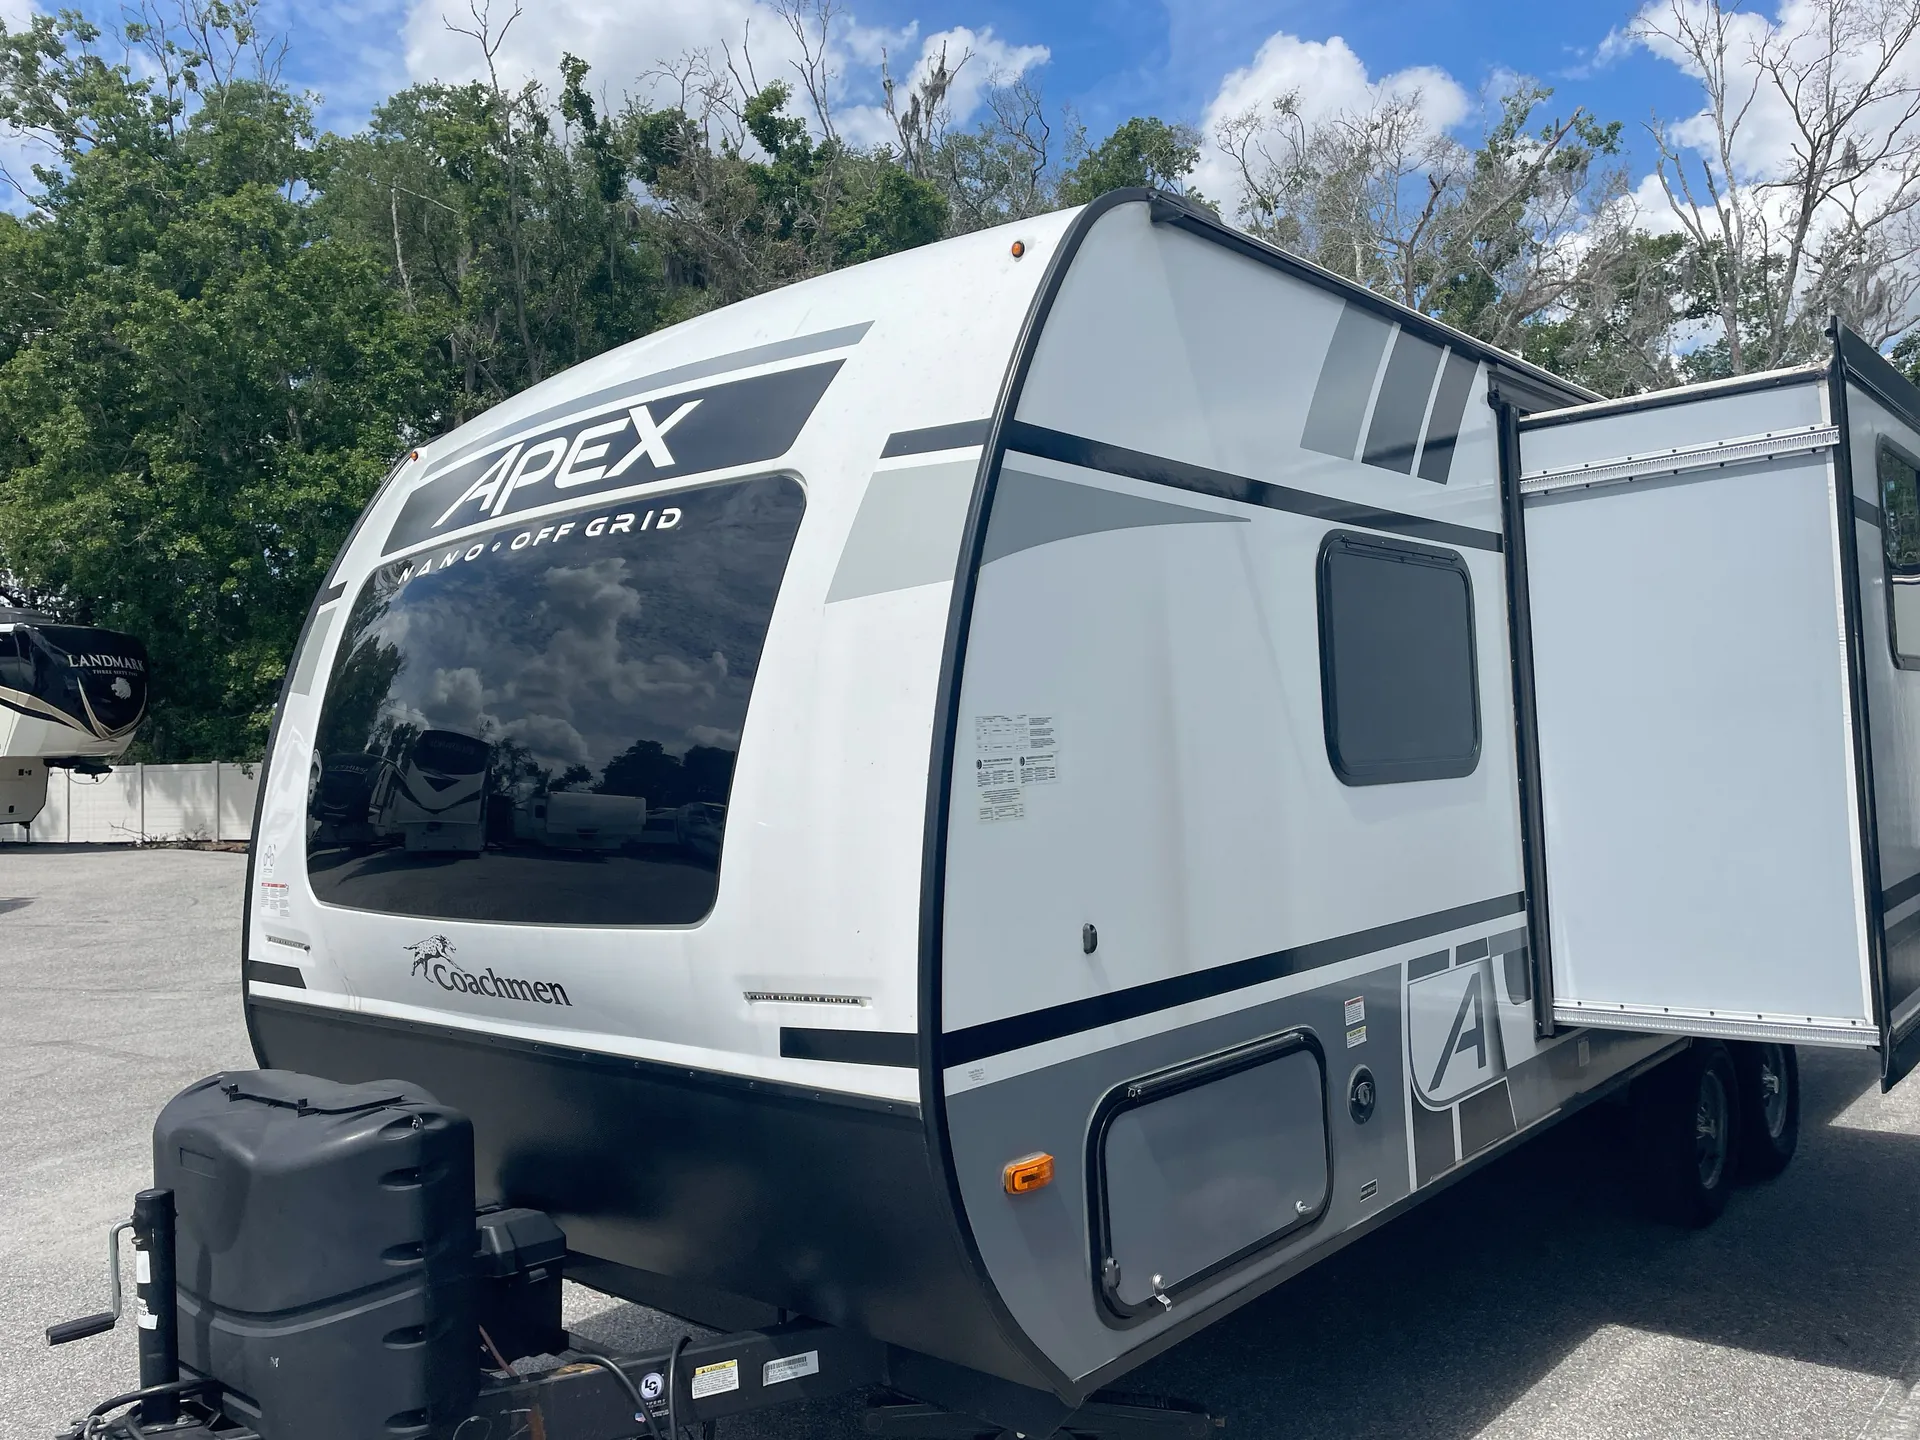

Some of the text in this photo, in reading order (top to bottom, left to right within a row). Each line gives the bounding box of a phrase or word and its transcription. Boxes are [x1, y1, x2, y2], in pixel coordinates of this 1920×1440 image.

[432, 399, 704, 528] APEX
[397, 507, 682, 585] NANO OFF GRID
[66, 654, 145, 672] LANDMARK
[433, 963, 573, 1007] Coachmen
